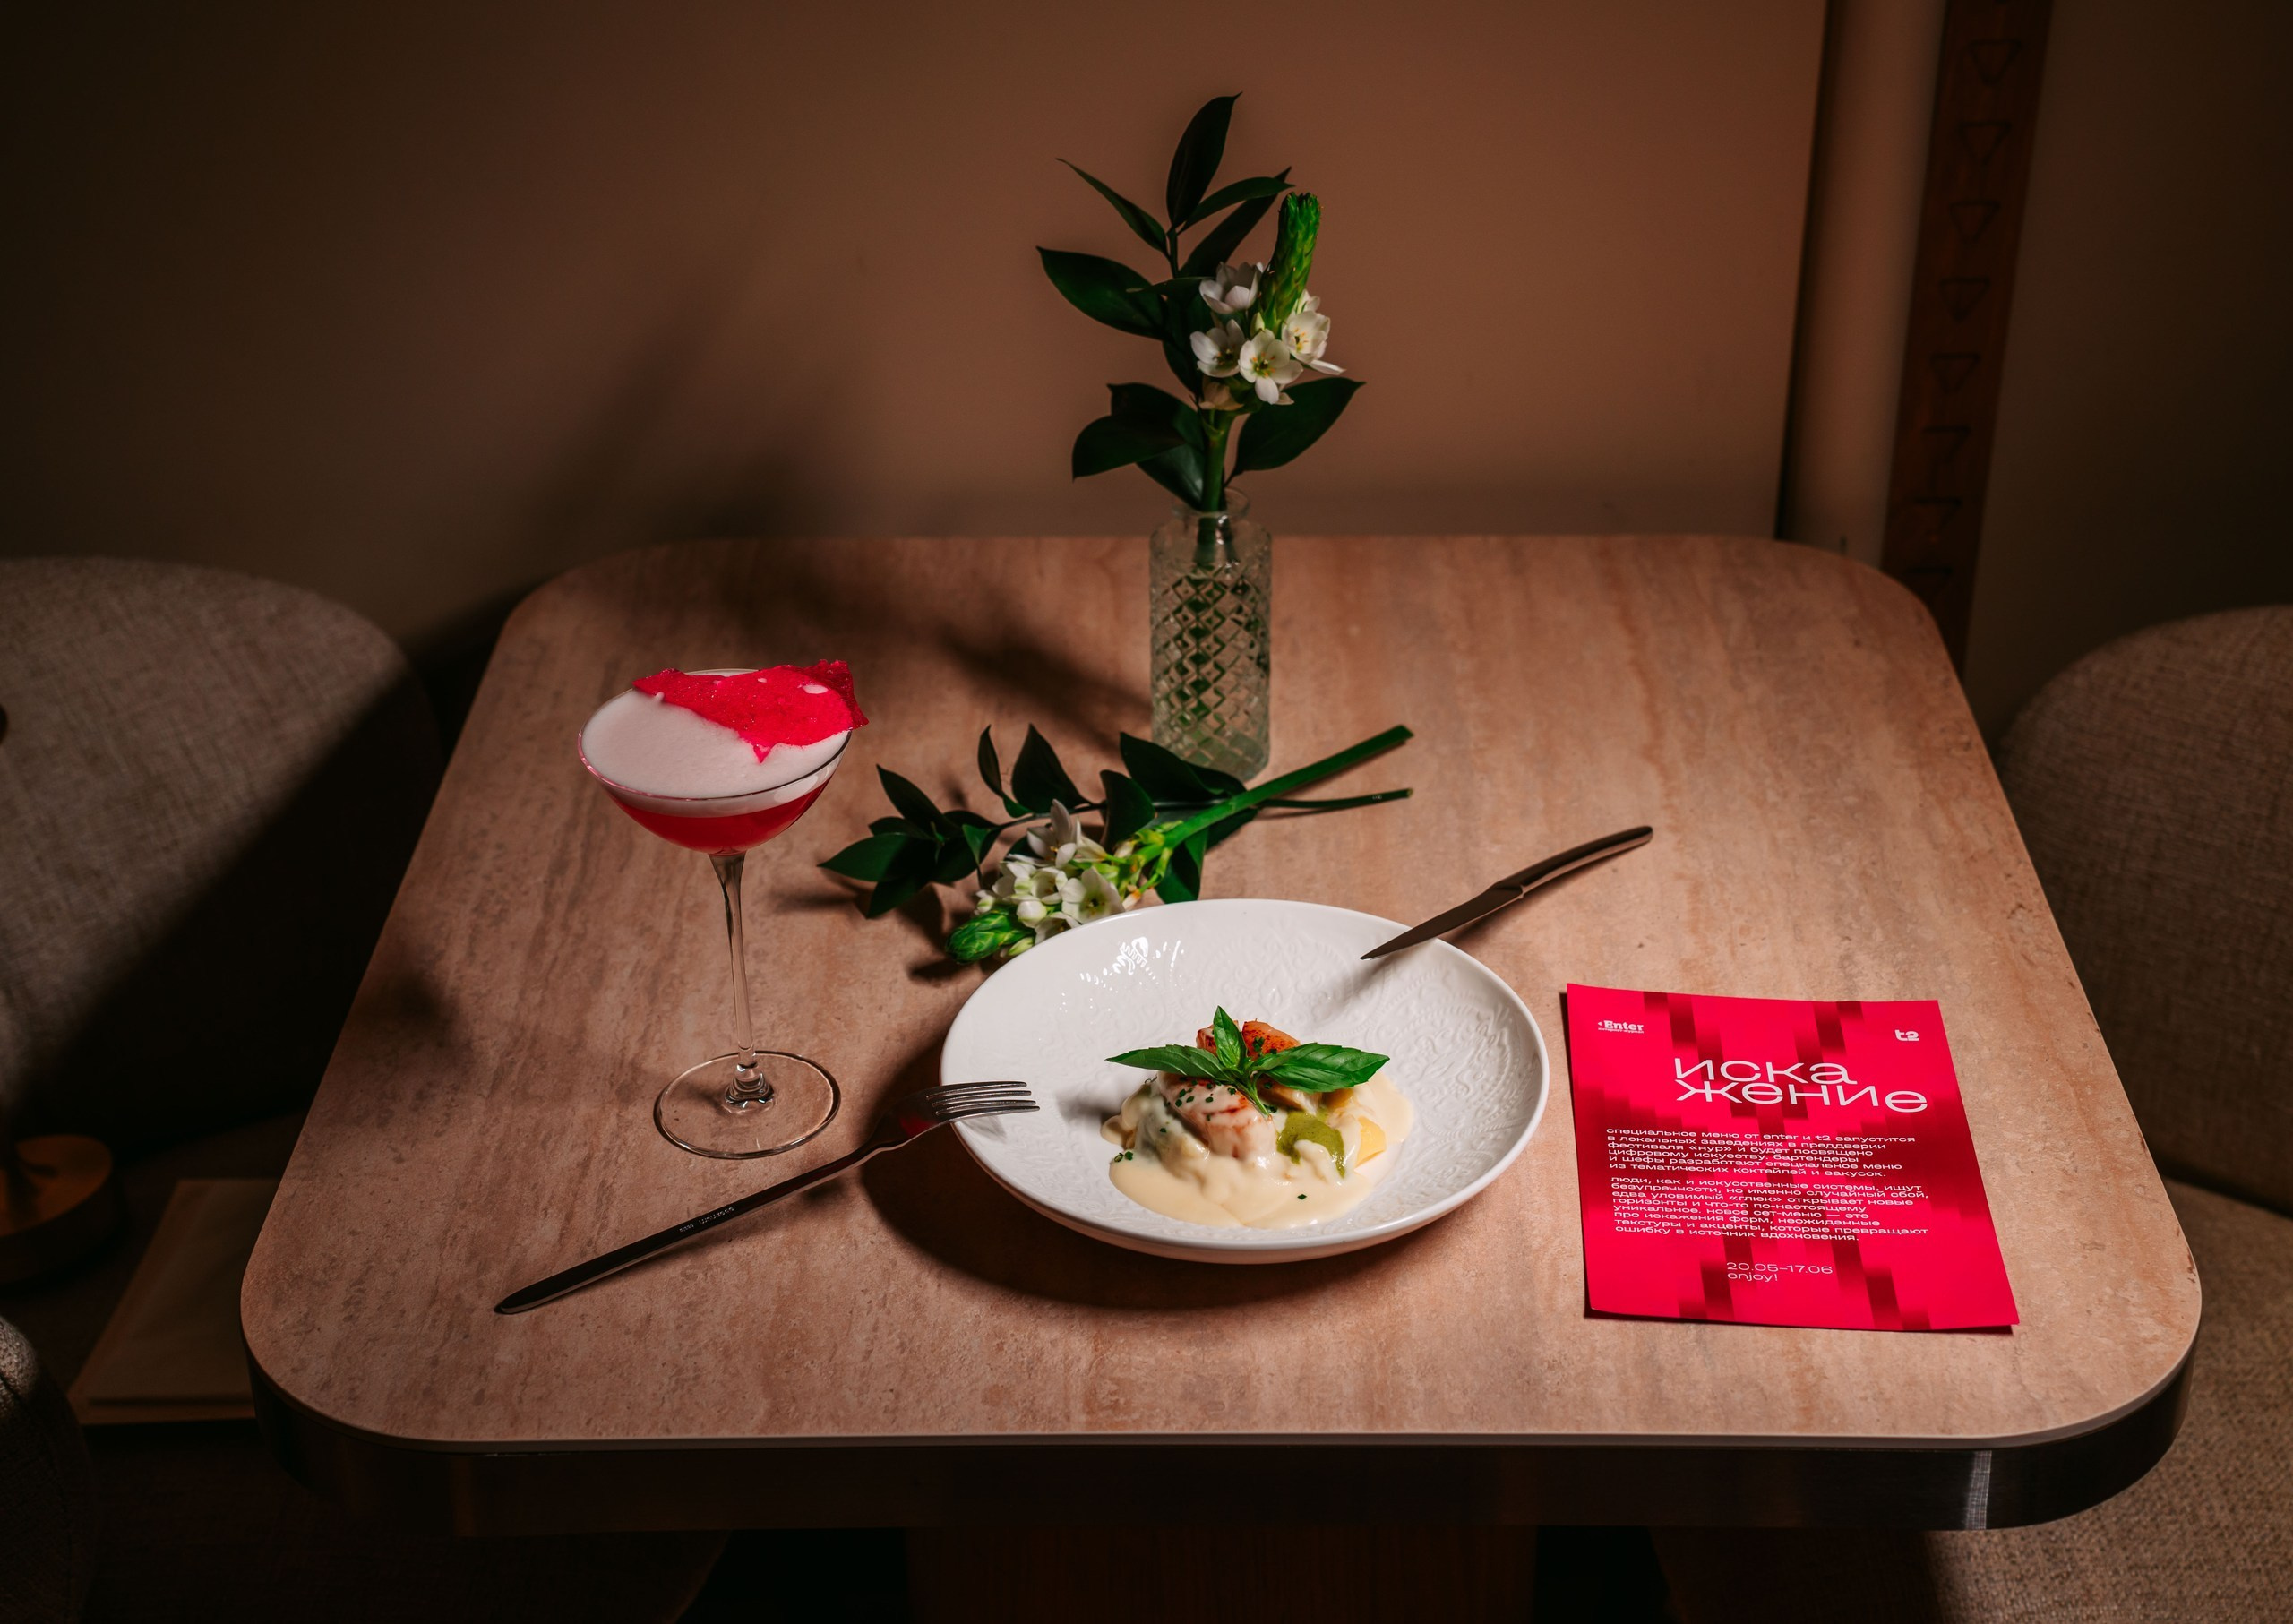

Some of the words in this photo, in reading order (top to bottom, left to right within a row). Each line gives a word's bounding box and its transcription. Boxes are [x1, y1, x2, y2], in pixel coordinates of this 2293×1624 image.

[1603, 1019, 1645, 1031] Enter
[1894, 1029, 1919, 1042] t2
[1674, 1058, 1858, 1085] иска
[1674, 1078, 1928, 1113] жение
[1607, 1129, 1696, 1137] специальное
[1608, 1141, 1683, 1150] фестиваля
[1609, 1149, 1689, 1158] цифровому
[1695, 1153, 1768, 1161] искусству.
[1773, 1154, 1859, 1163] бартендеры
[1699, 1181, 1808, 1189] искусственные
[1611, 1182, 1721, 1193] безупречности,
[1891, 1190, 1928, 1199] сбой,
[1754, 1204, 1866, 1213] по-настоящему
[1729, 1216, 1773, 1224] форм,
[1616, 1226, 1670, 1234] ошибку
[1727, 1272, 1778, 1282] enjoy!
